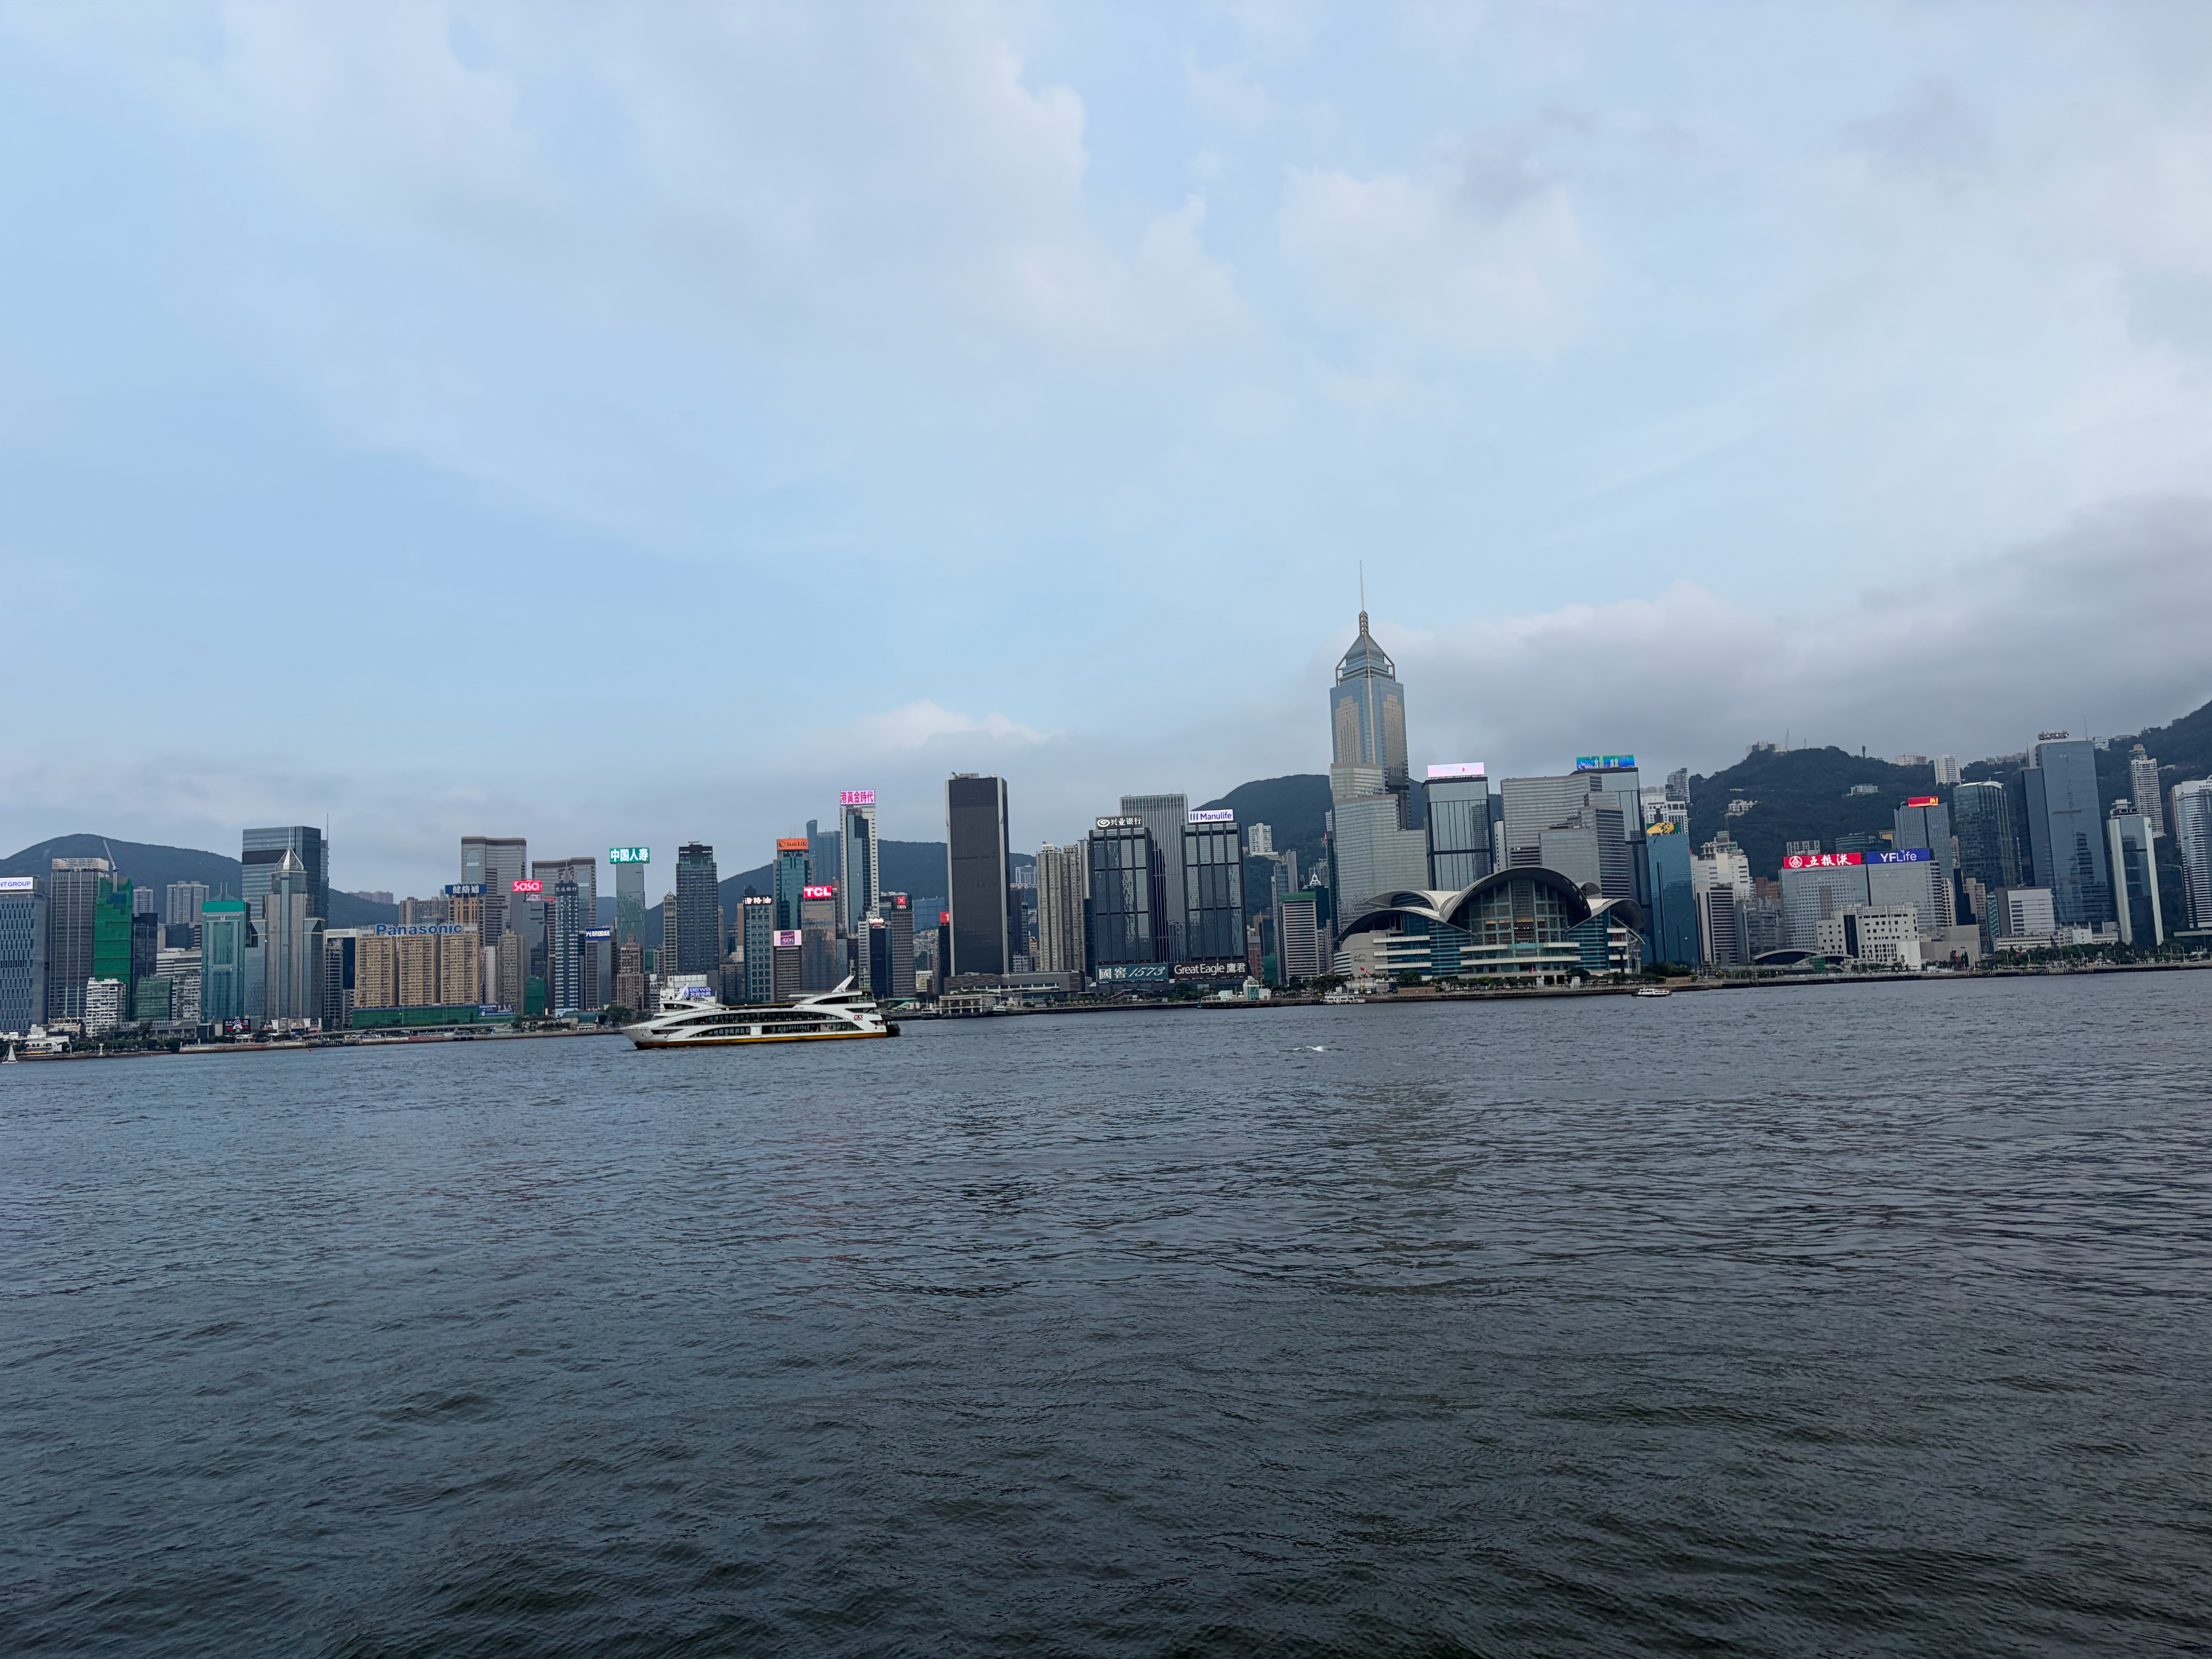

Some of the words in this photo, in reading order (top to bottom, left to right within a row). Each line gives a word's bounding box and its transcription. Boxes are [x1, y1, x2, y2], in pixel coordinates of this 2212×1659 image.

[840, 791, 875, 804] 港黃金時代
[1111, 817, 1141, 826] 兴业银行
[1200, 812, 1232, 820] Manulife
[1805, 853, 1853, 867] 五粮液
[1880, 850, 1917, 862] YFLife
[804, 888, 831, 896] TCL
[376, 922, 462, 936] Panasonic
[1128, 966, 1165, 977] 1573
[1174, 965, 1199, 974] Great
[1200, 963, 1224, 975] Eagle
[1226, 963, 1246, 973] 鷹君
